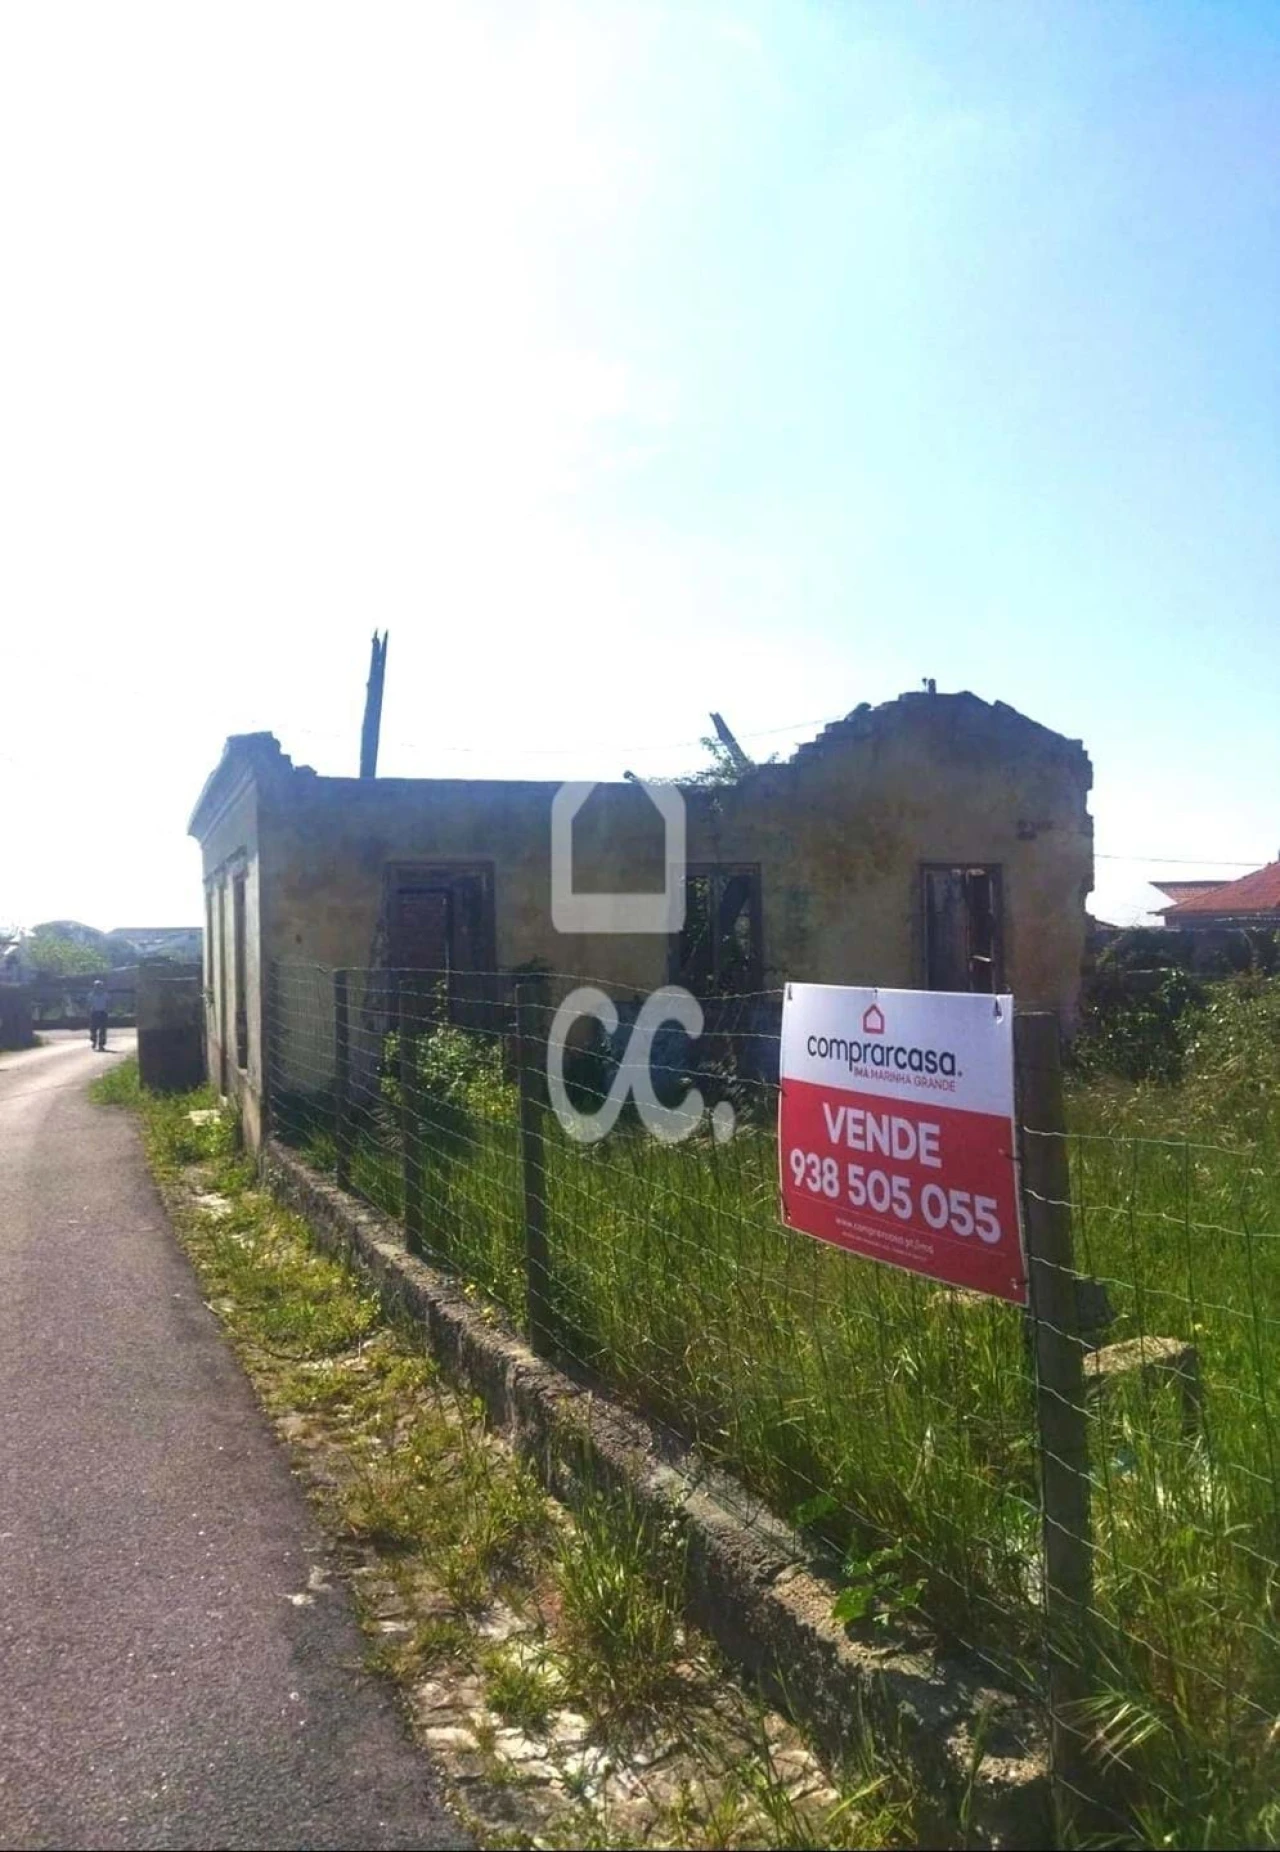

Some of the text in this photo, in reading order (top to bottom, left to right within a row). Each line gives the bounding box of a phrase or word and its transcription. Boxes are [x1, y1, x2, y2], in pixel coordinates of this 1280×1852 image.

[807, 1034, 963, 1077] comprarcasa.
[870, 1069, 912, 1085] MARINHA
[914, 1076, 956, 1092] GRANDE
[822, 1102, 942, 1169] VENDE
[790, 1148, 1002, 1244] 938 505 055
